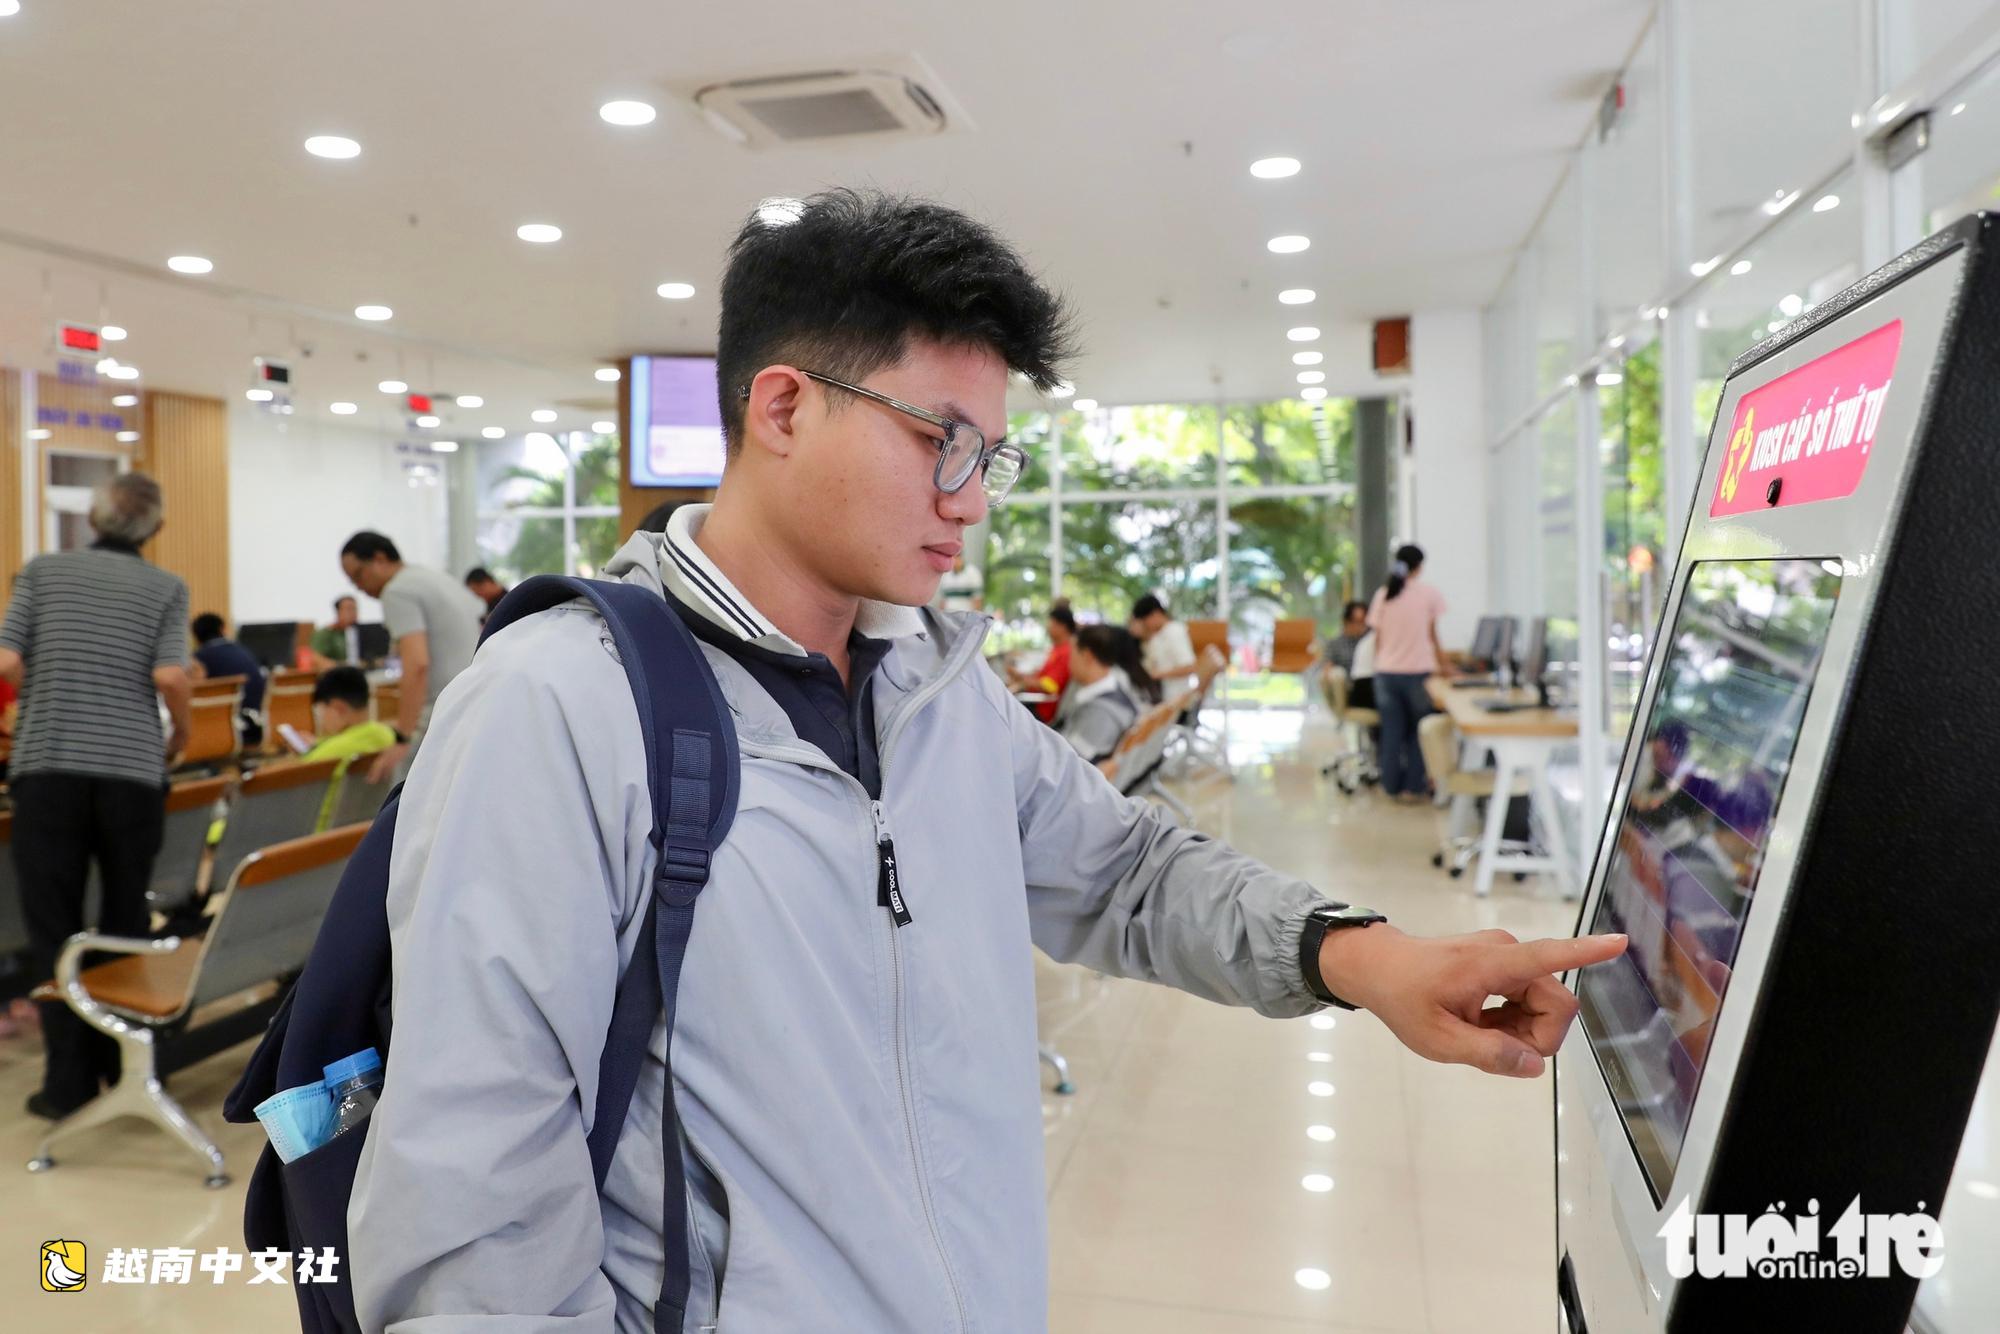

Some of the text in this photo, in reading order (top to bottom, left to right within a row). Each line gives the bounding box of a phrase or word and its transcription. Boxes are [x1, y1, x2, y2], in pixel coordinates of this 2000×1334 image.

[1749, 421, 1788, 472] KIOSK
[1781, 398, 1812, 464] CẤP
[1806, 386, 1839, 457] SỐ
